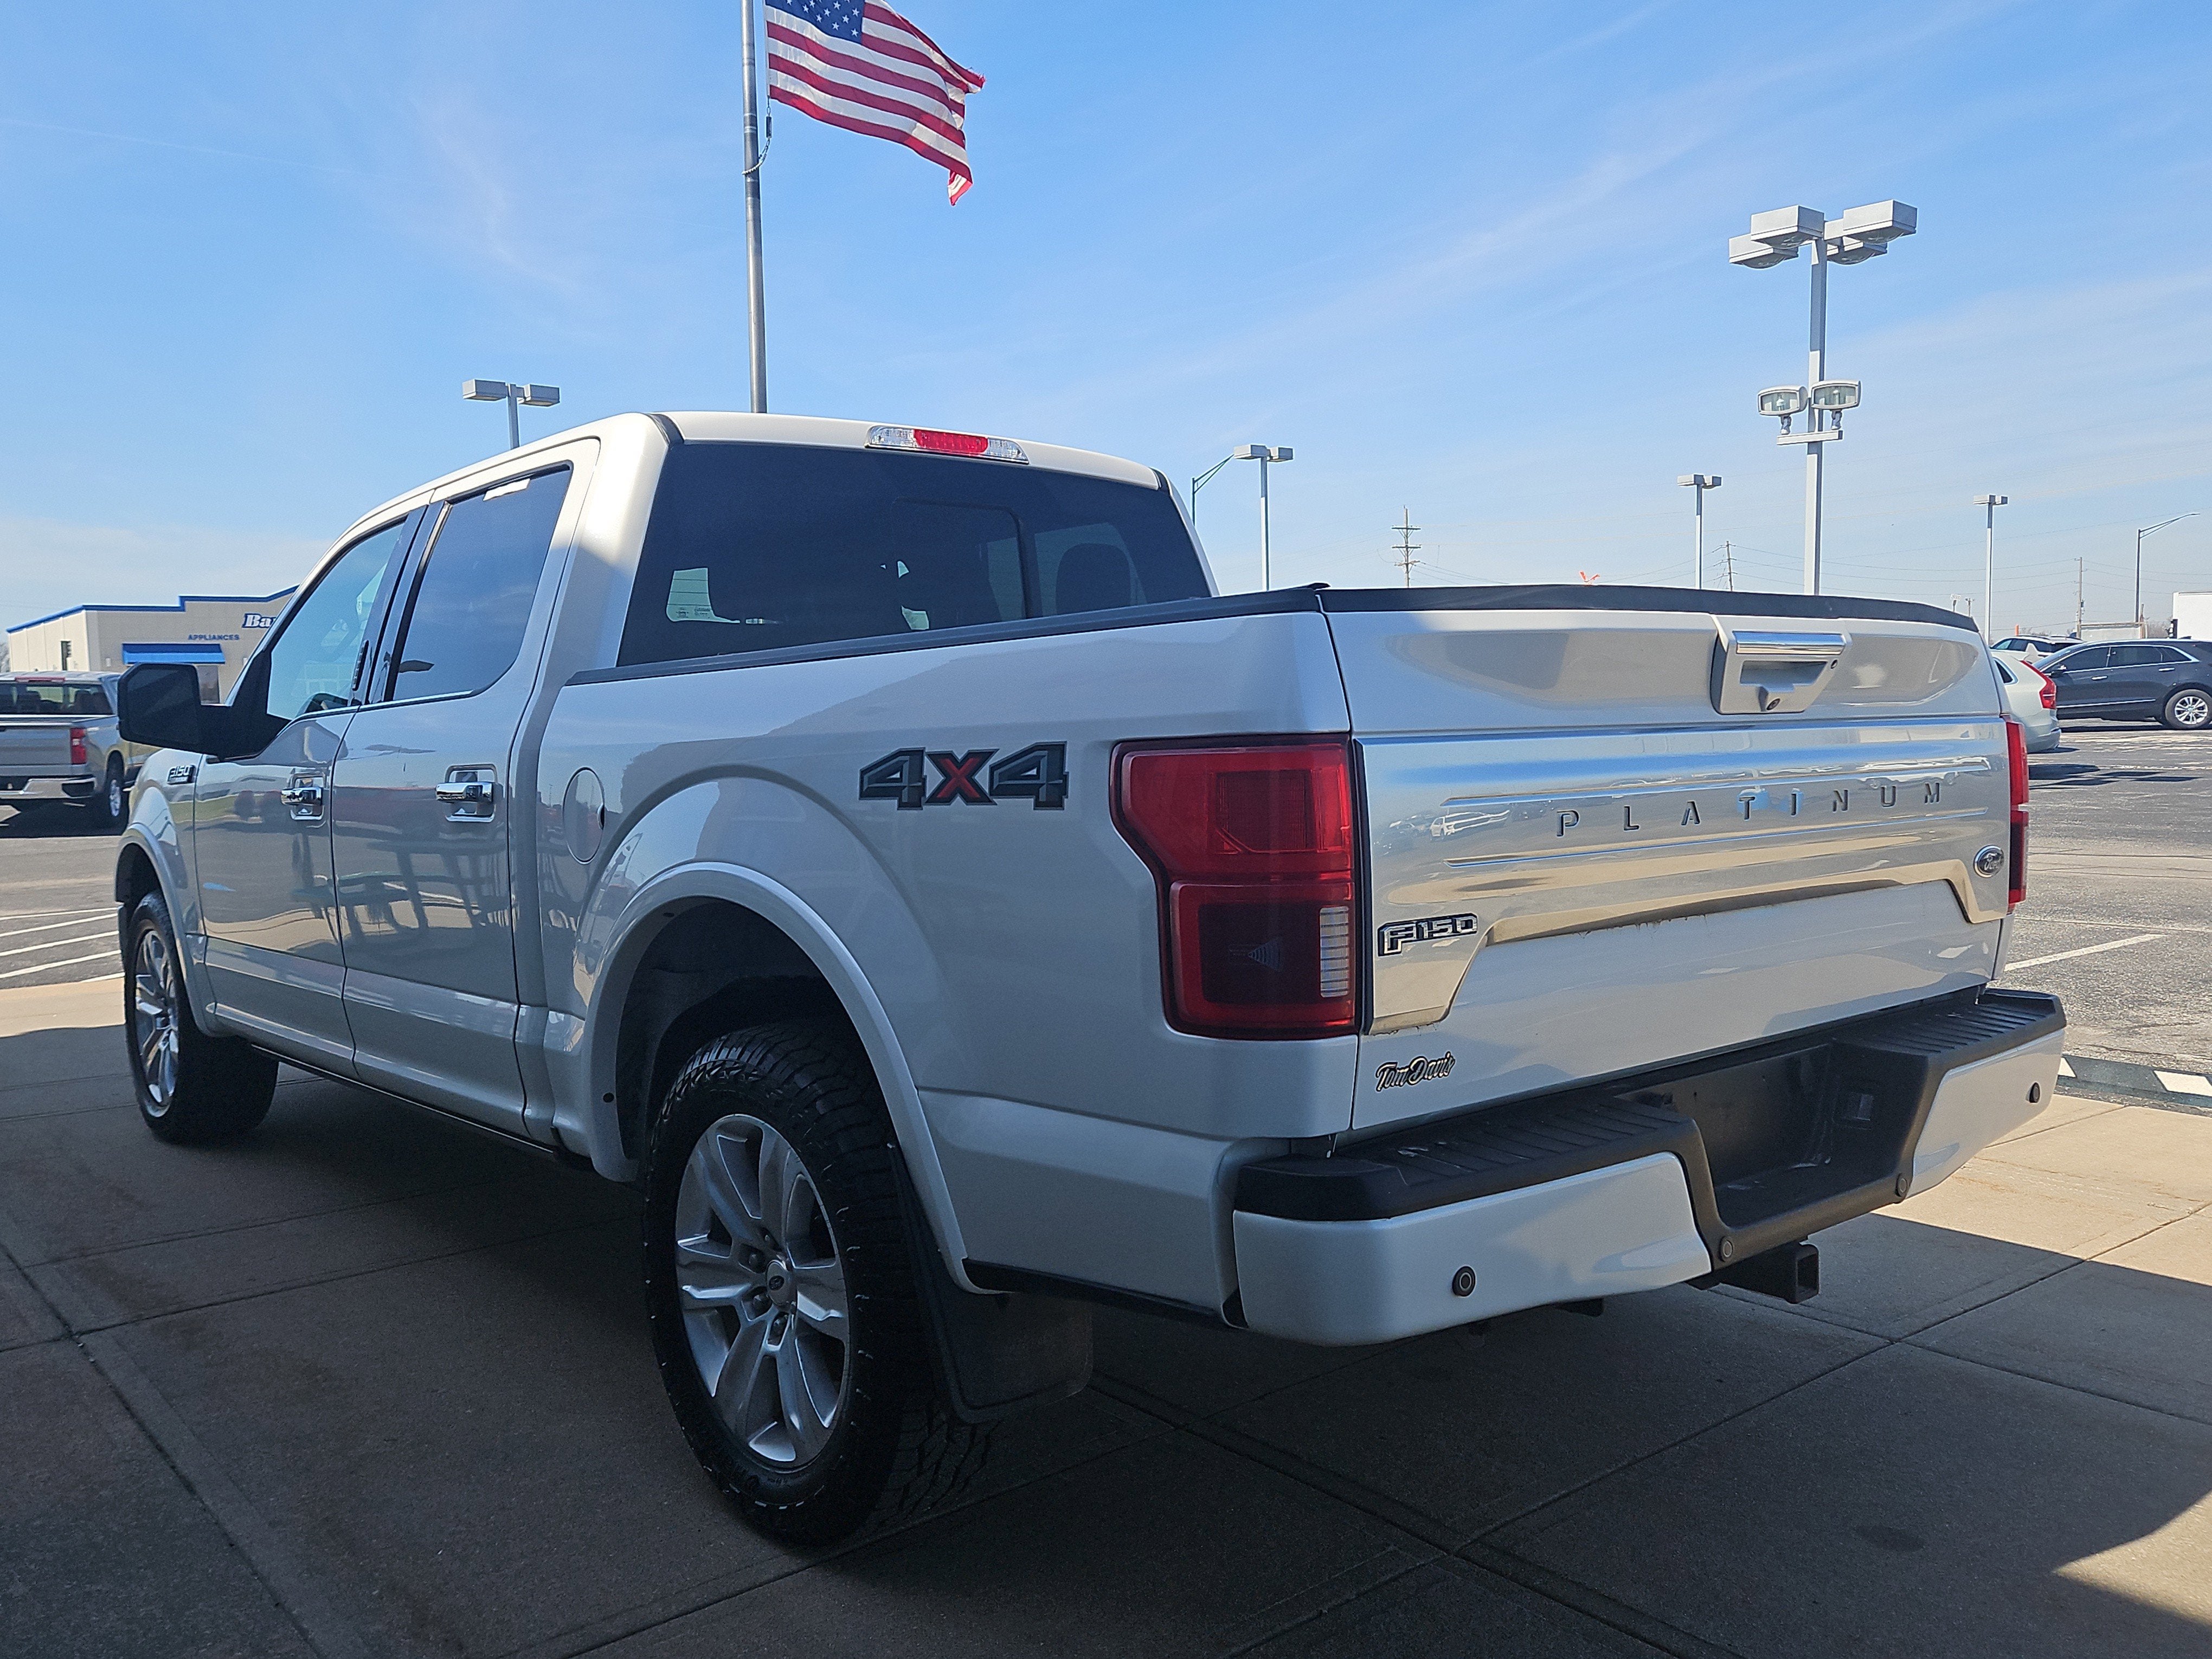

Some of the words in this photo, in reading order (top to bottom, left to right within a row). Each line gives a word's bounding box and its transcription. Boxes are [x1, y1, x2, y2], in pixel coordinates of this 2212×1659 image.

[1556, 782, 1941, 838] PLATINUM
[1375, 1062, 1410, 1092] Tom
[1407, 1051, 1456, 1085] Davis
